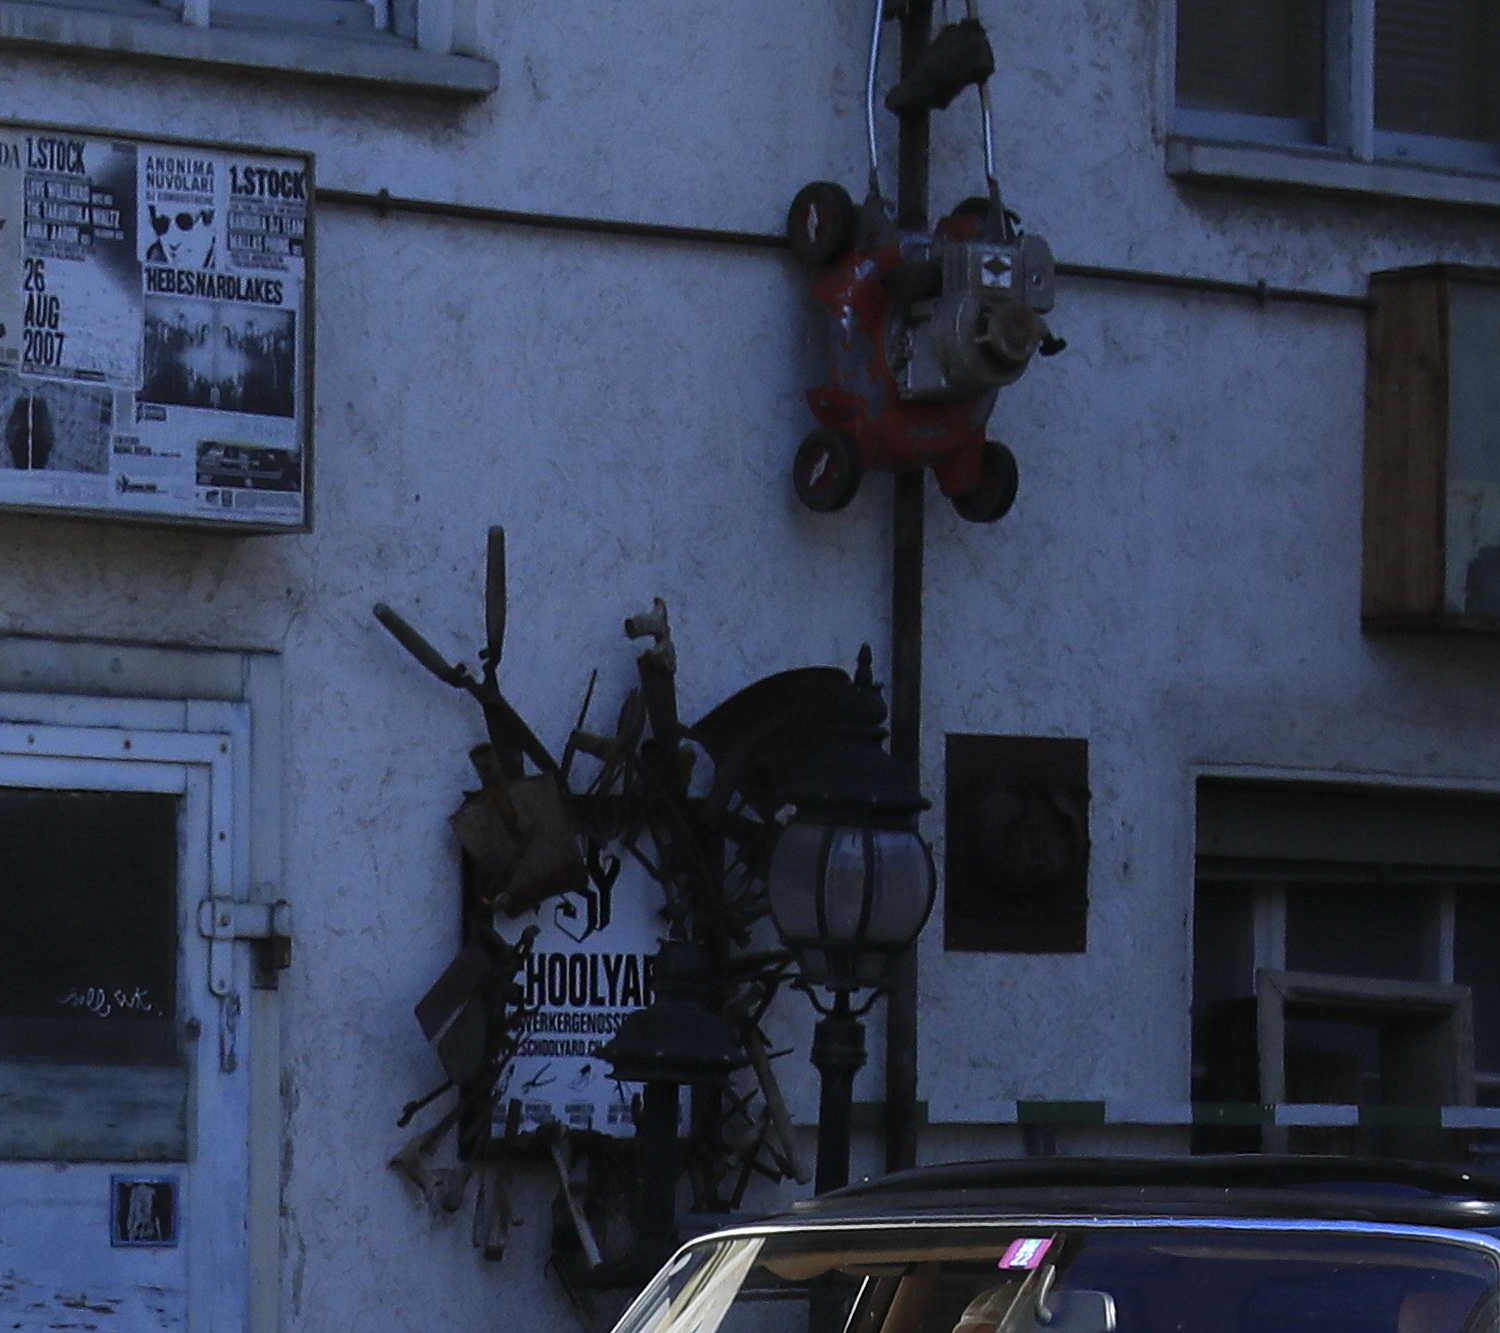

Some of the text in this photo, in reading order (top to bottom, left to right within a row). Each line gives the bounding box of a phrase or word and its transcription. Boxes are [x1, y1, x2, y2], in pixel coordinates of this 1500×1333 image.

[26, 137, 85, 174] 1.STOCK
[146, 156, 215, 176] ANONIMA
[146, 174, 215, 193] NUVOLARI
[230, 166, 305, 199] 1.STOCK
[24, 259, 45, 292] 26
[25, 294, 60, 329] AUG
[24, 330, 64, 367] 2007
